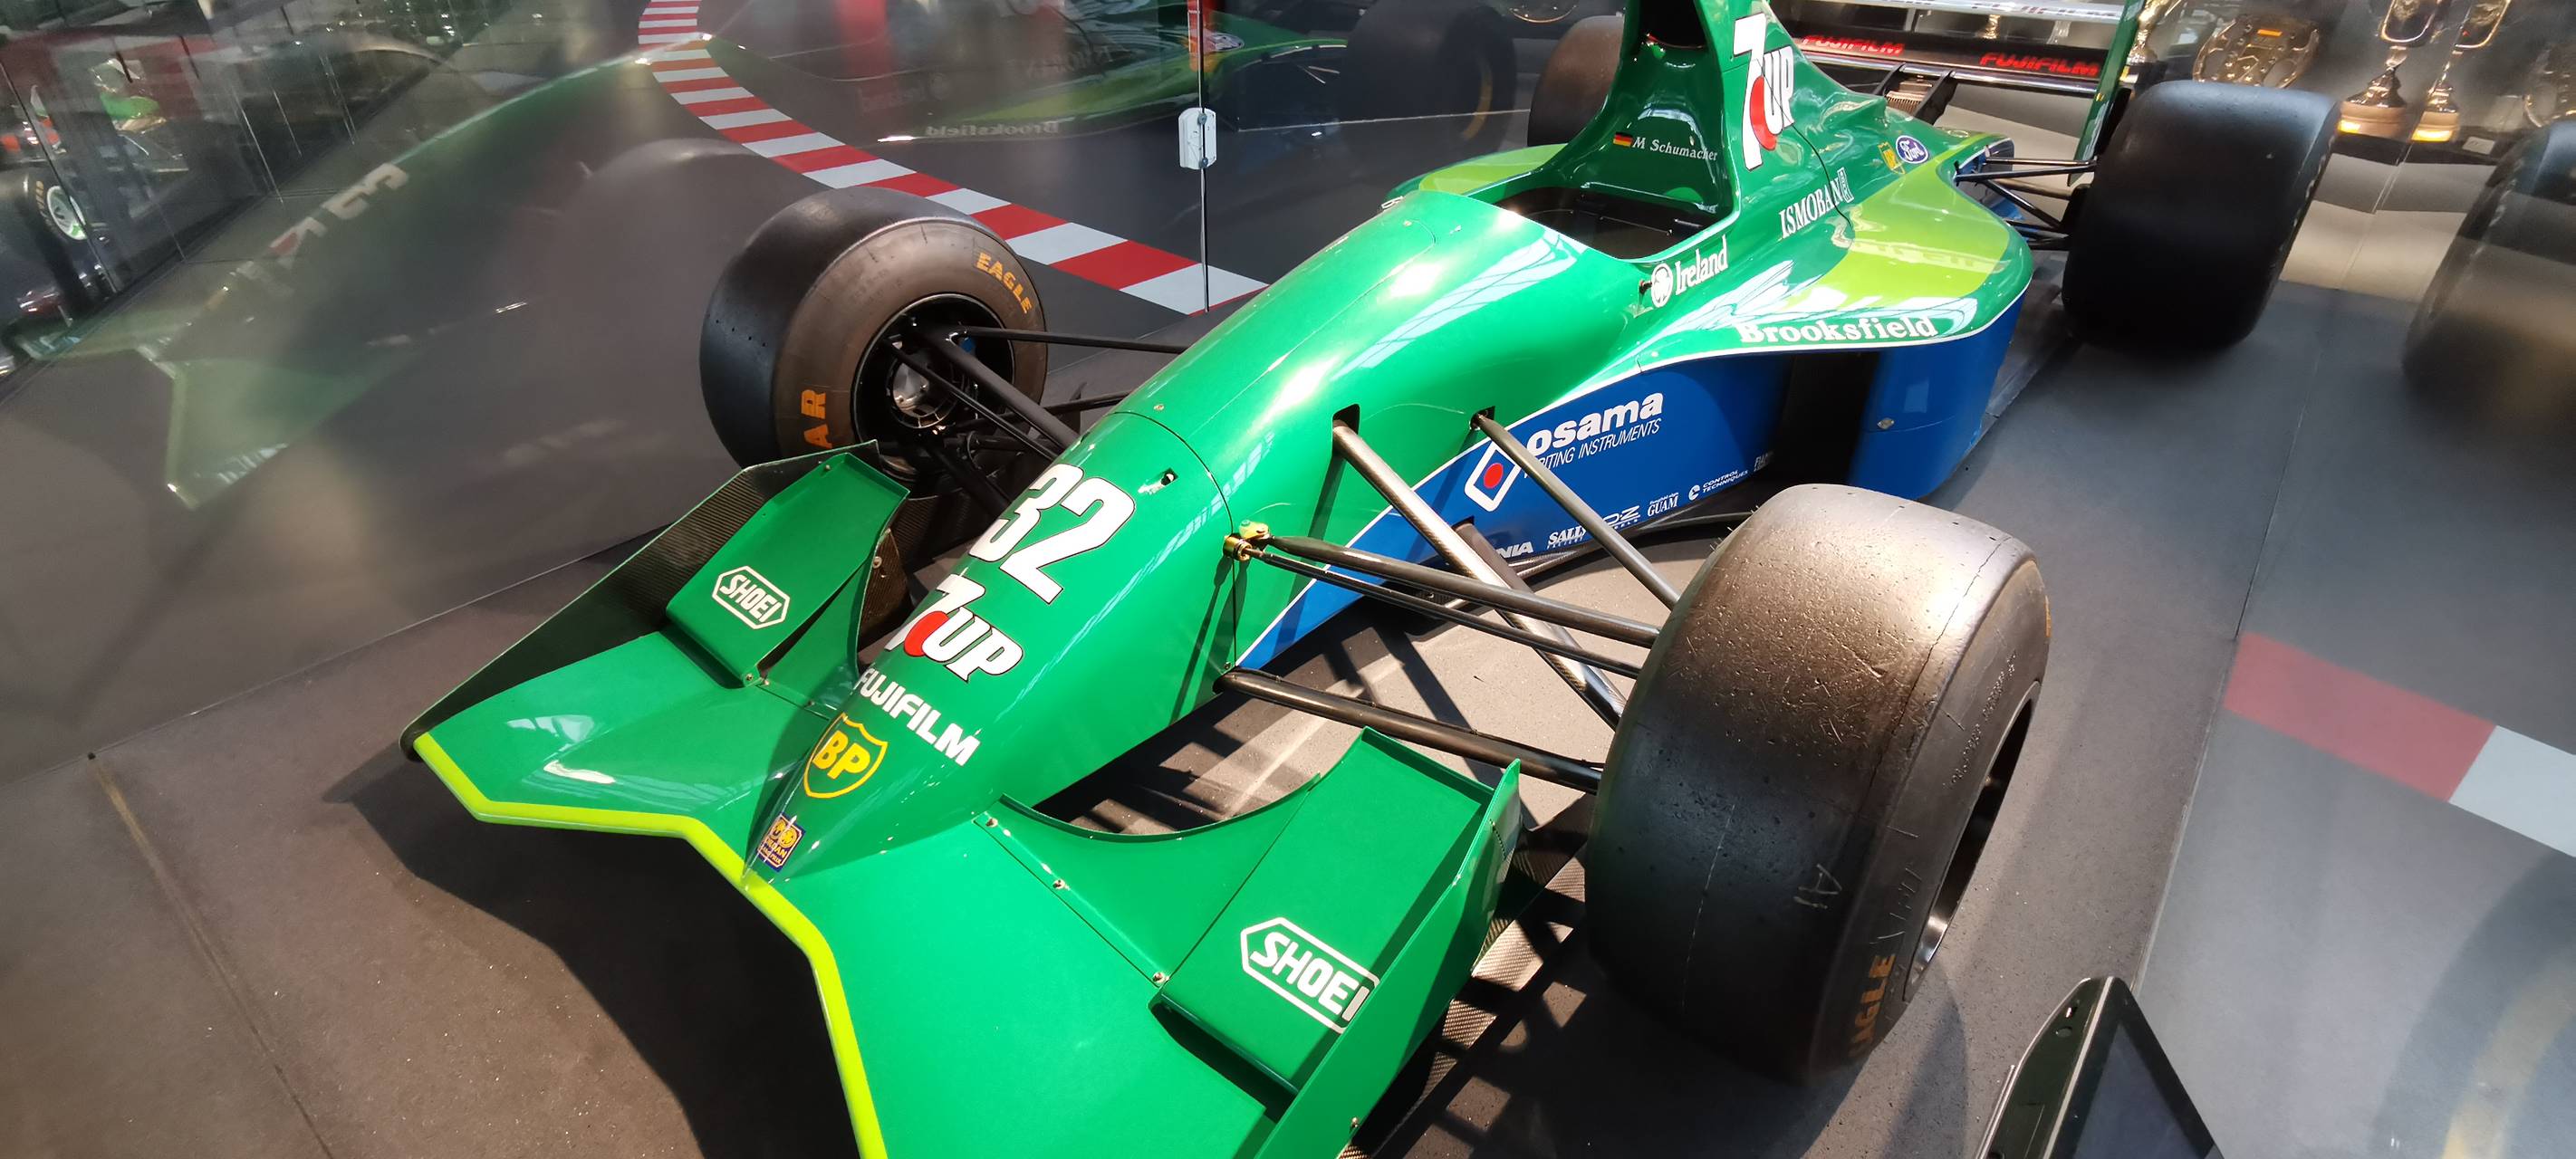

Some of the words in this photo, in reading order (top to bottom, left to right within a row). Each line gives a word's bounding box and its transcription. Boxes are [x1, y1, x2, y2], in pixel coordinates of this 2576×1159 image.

[1734, 12, 1794, 172] 7UP
[1979, 52, 2100, 78] FUJIFILM
[1632, 137, 1646, 148] M
[1650, 139, 1718, 160] Schumacher
[1779, 178, 1843, 240] ISMOBAN
[976, 252, 1033, 314] EAGLE
[1675, 235, 1728, 295] Ireland
[1736, 315, 1938, 343] Brooksfield
[1526, 393, 1664, 456] osama
[1578, 417, 1662, 459] INSTRUMENTS
[1648, 495, 1679, 517] GUAM
[1703, 470, 1738, 488] CONTROL
[1703, 470, 1749, 493] TECHNIQUES
[968, 463, 1135, 605] 32
[719, 574, 783, 623] SHOEI
[884, 573, 1024, 683] 7UP
[853, 667, 981, 766] FUJIFILM
[812, 730, 870, 780] BP
[1250, 932, 1370, 1022] SHOEI
